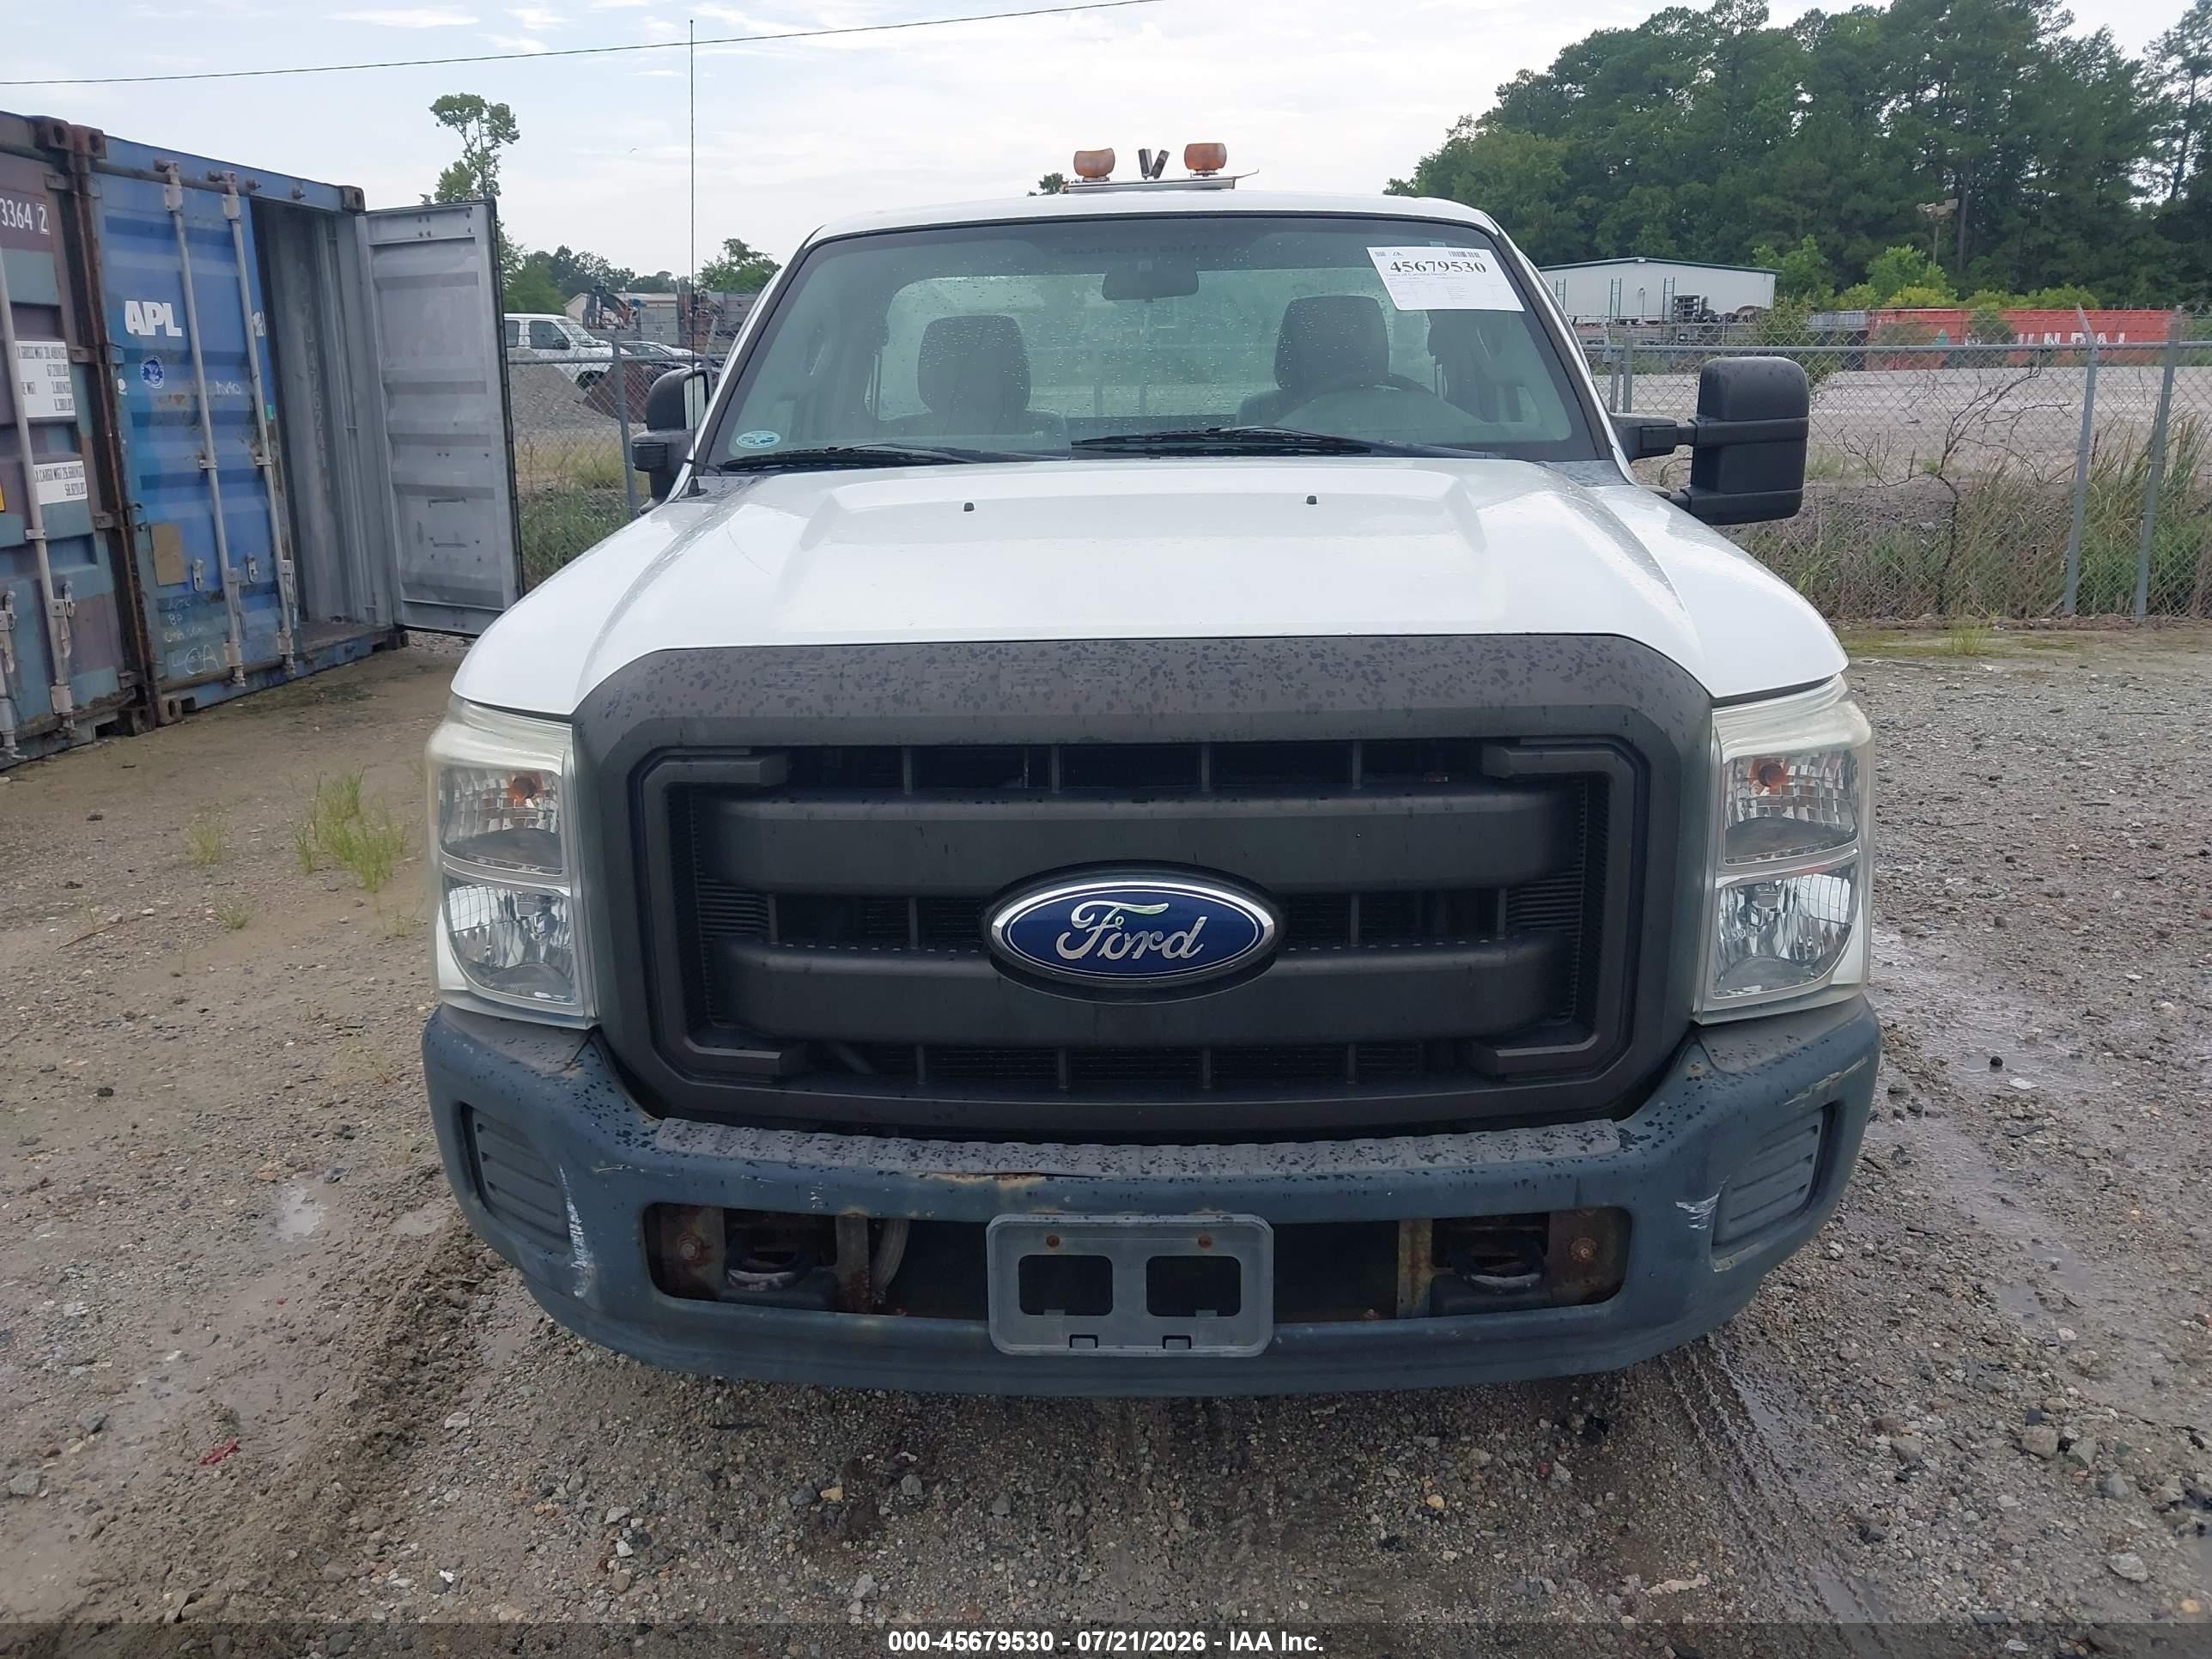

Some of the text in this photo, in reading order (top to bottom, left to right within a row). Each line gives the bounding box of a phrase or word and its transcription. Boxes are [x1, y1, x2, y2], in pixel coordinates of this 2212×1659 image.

[40, 204, 49, 234] 2
[1389, 260, 1486, 273] 45679530
[125, 301, 183, 337] APL
[1055, 900, 1208, 959] Ford
